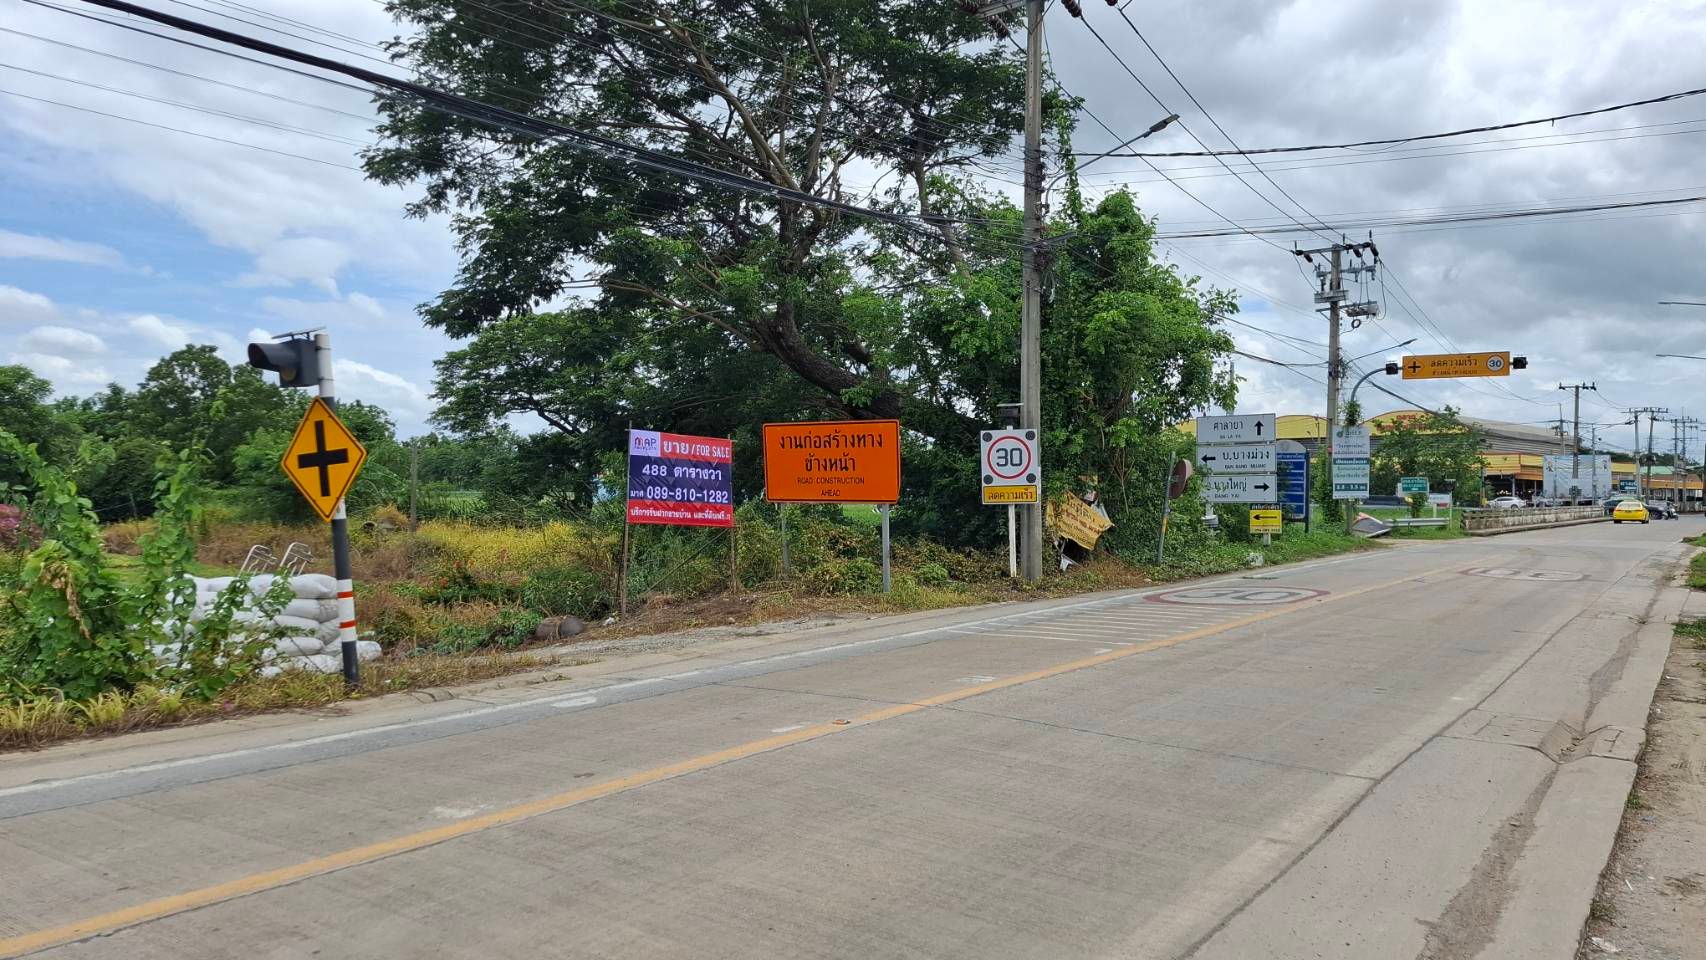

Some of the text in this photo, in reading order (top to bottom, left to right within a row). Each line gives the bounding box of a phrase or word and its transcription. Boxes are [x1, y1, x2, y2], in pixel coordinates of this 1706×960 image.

[1488, 360, 1501, 368] 30
[780, 429, 883, 449] งานก่อสร้างทาง
[712, 445, 730, 458] SALE
[996, 448, 1022, 467] 30
[1222, 447, 1270, 461] บ.บางม่วง
[805, 452, 856, 471] ข้างหน้า
[642, 464, 722, 480] 488 ตารางวา
[797, 477, 865, 485] ROAD CONSTRUCTION
[647, 486, 729, 503] 089-810-1282
[988, 487, 1033, 500] ลดความเร็ว
